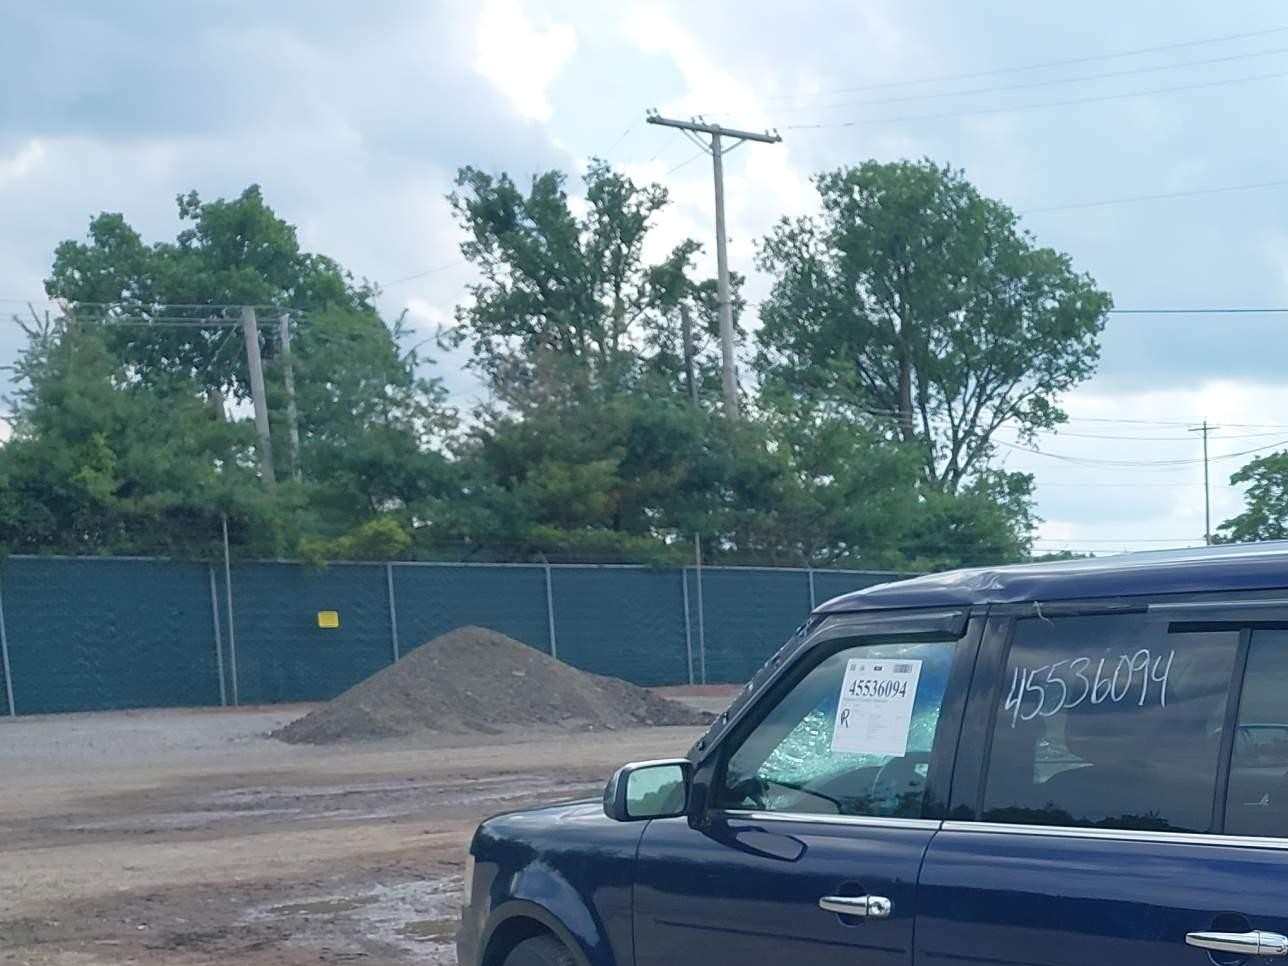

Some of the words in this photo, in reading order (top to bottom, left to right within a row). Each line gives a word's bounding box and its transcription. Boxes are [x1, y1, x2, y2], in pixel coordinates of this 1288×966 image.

[849, 679, 908, 698] 45536094
[1004, 648, 1175, 729] 45536094
[840, 708, 850, 729] R
